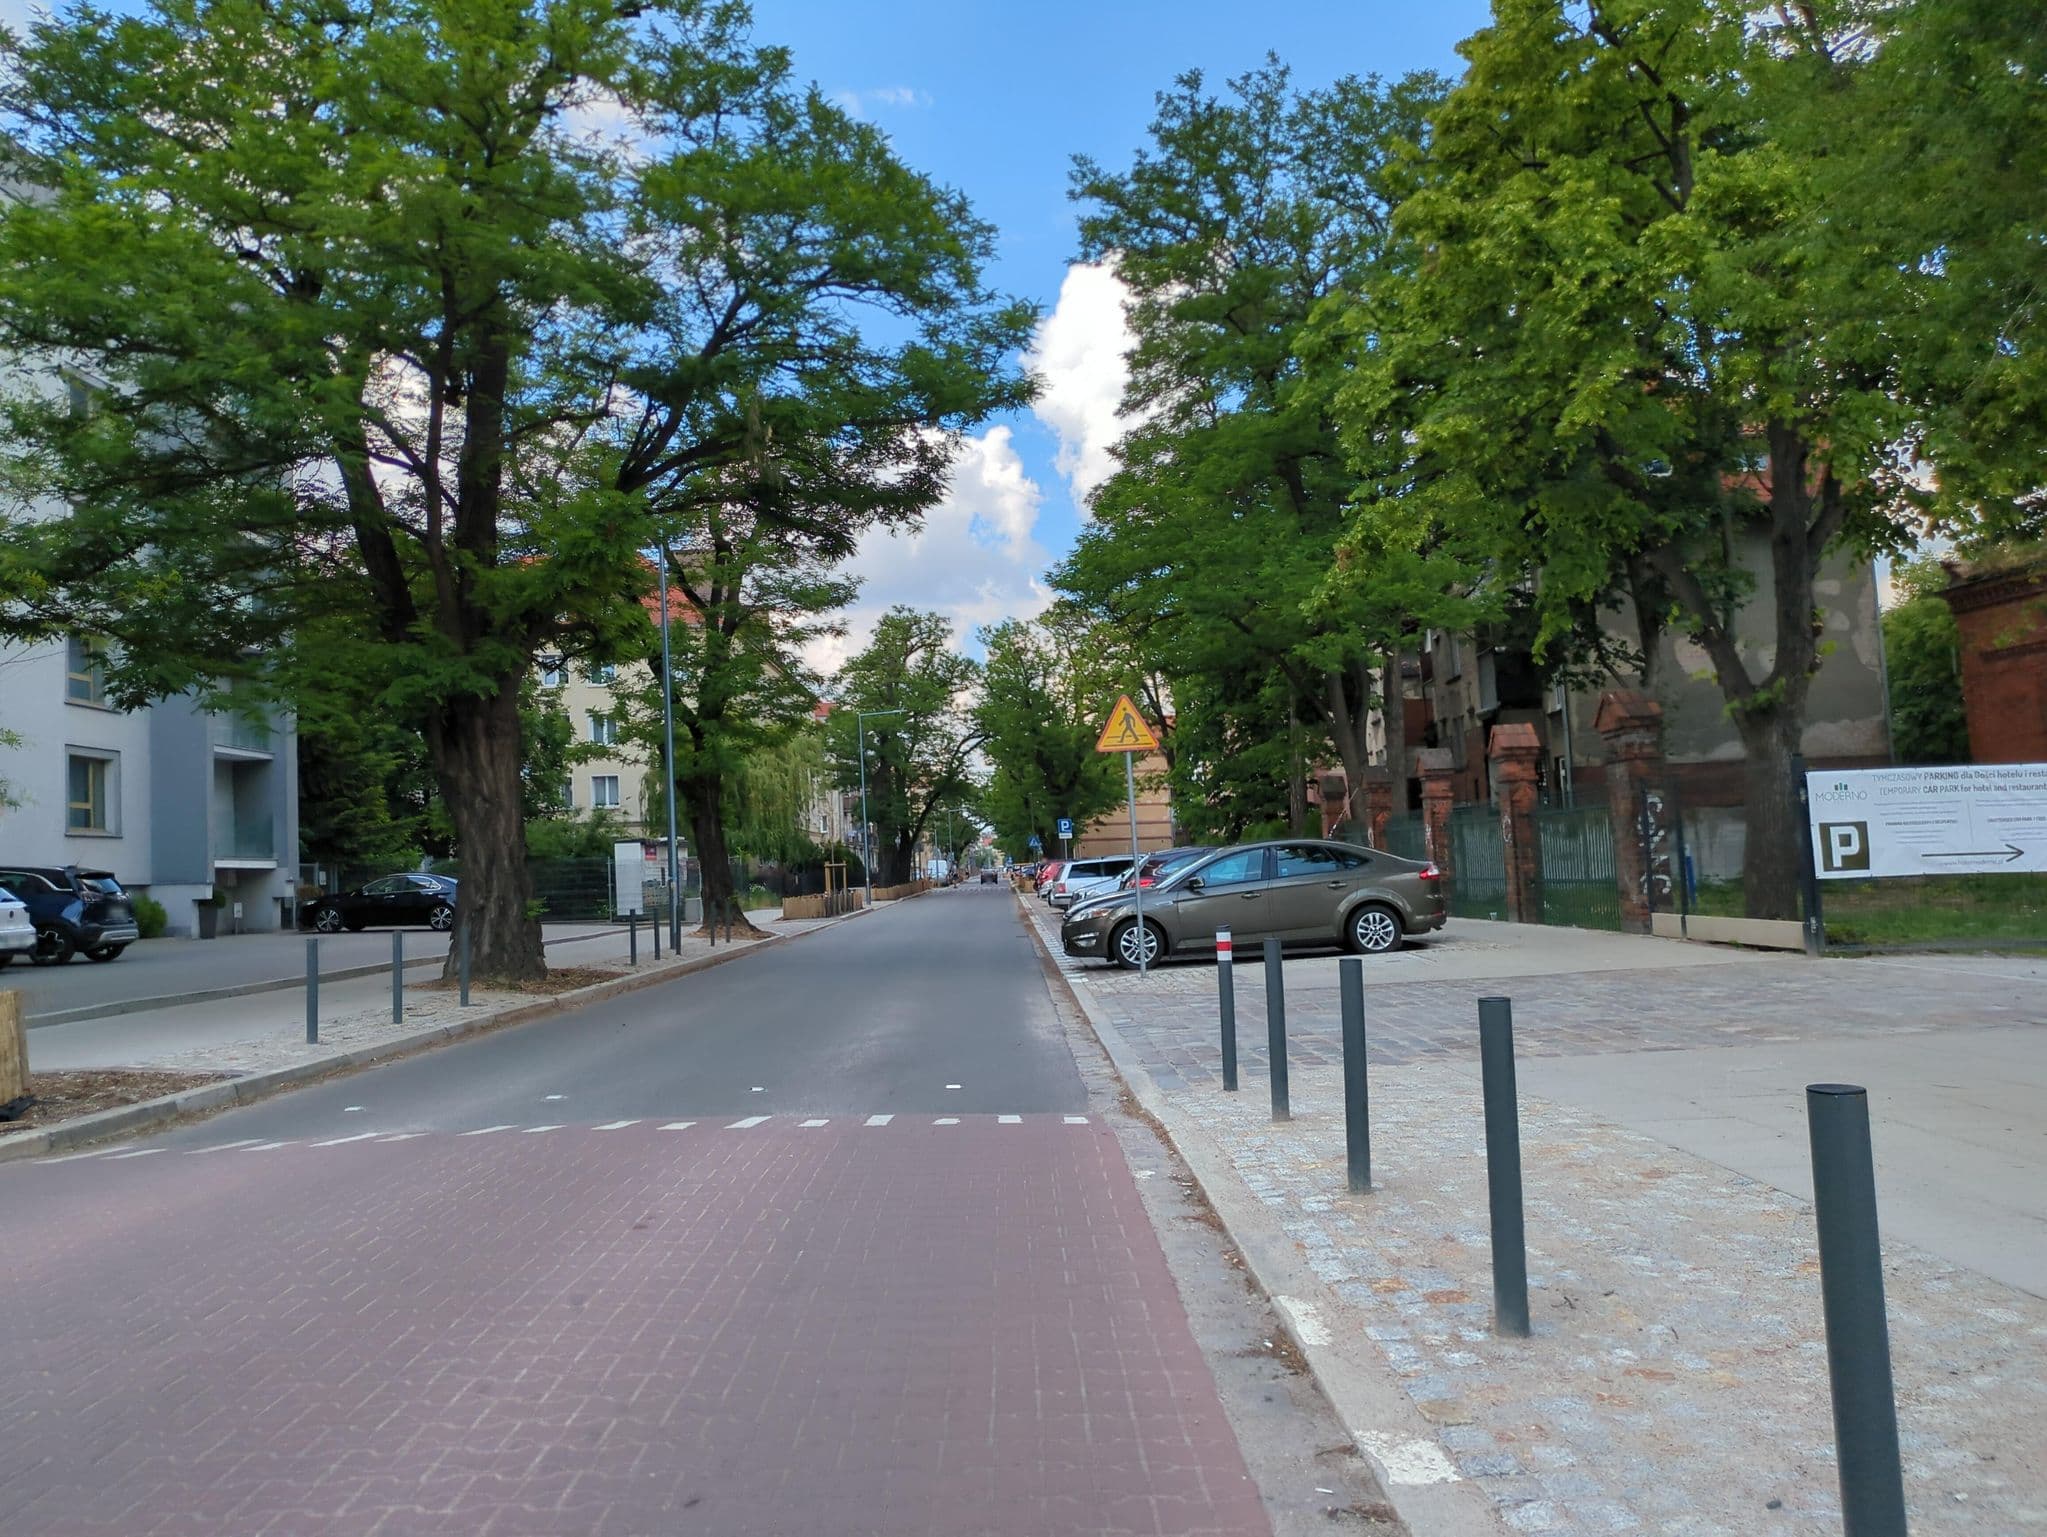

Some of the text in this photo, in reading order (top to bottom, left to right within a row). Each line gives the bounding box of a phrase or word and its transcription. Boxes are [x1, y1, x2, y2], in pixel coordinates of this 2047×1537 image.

[1924, 771, 1959, 780] PARKING
[1960, 770, 1973, 780] dla
[1997, 769, 2023, 779] hotelu
[1922, 785, 1938, 794] CAR
[1940, 784, 1959, 793] PARK
[1960, 783, 1972, 793] for
[1973, 783, 1992, 793] hotel
[1994, 783, 2007, 792] and
[1815, 791, 1868, 802] MODERNO
[1061, 820, 1070, 831] P
[1829, 825, 1860, 868] P
